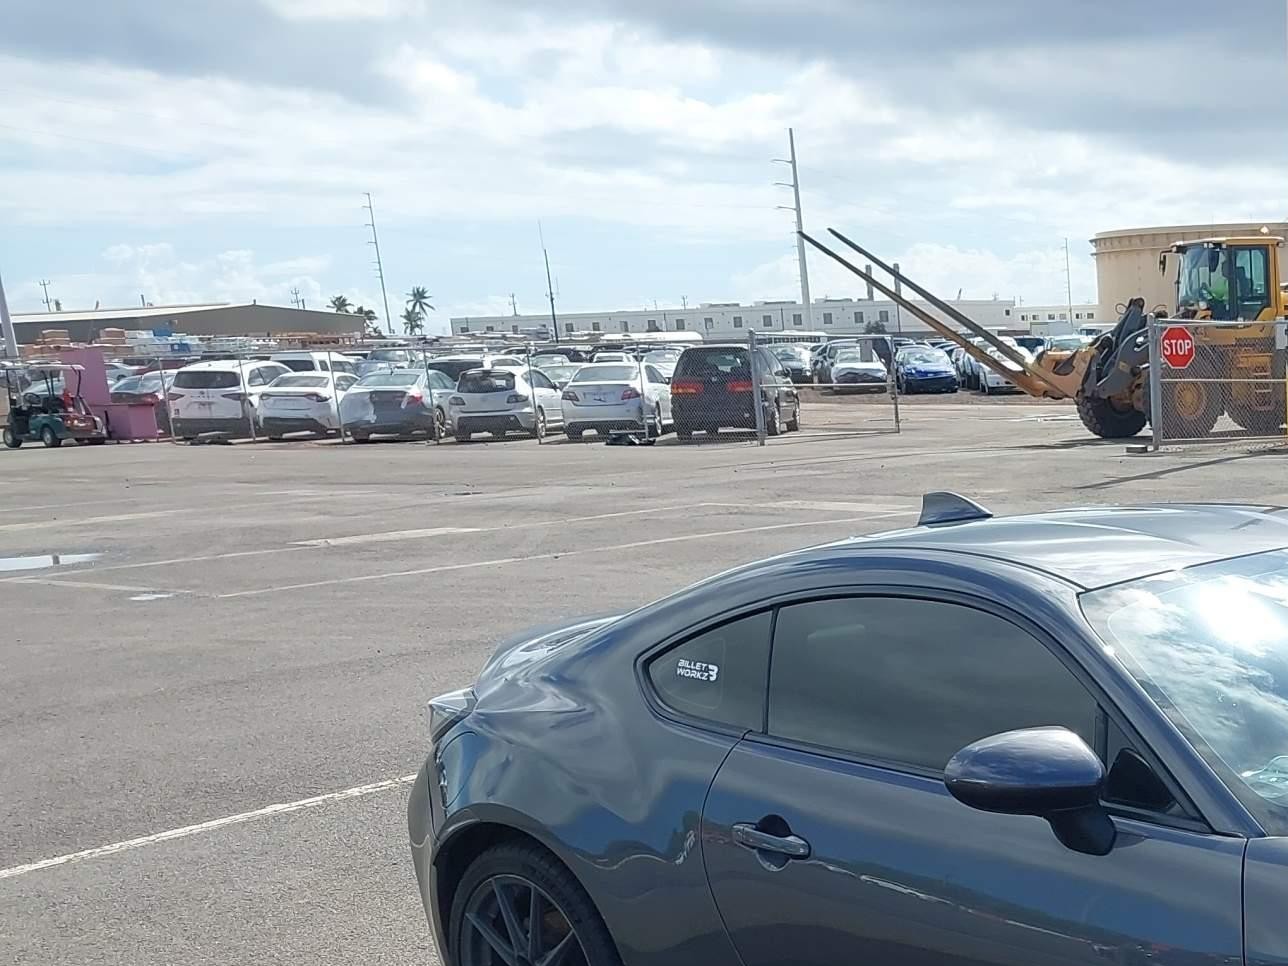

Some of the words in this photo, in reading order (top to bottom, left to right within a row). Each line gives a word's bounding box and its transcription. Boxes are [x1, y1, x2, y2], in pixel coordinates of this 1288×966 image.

[1163, 339, 1192, 355] STOP
[678, 659, 708, 670] BILLET
[677, 667, 708, 680] WORKZ
